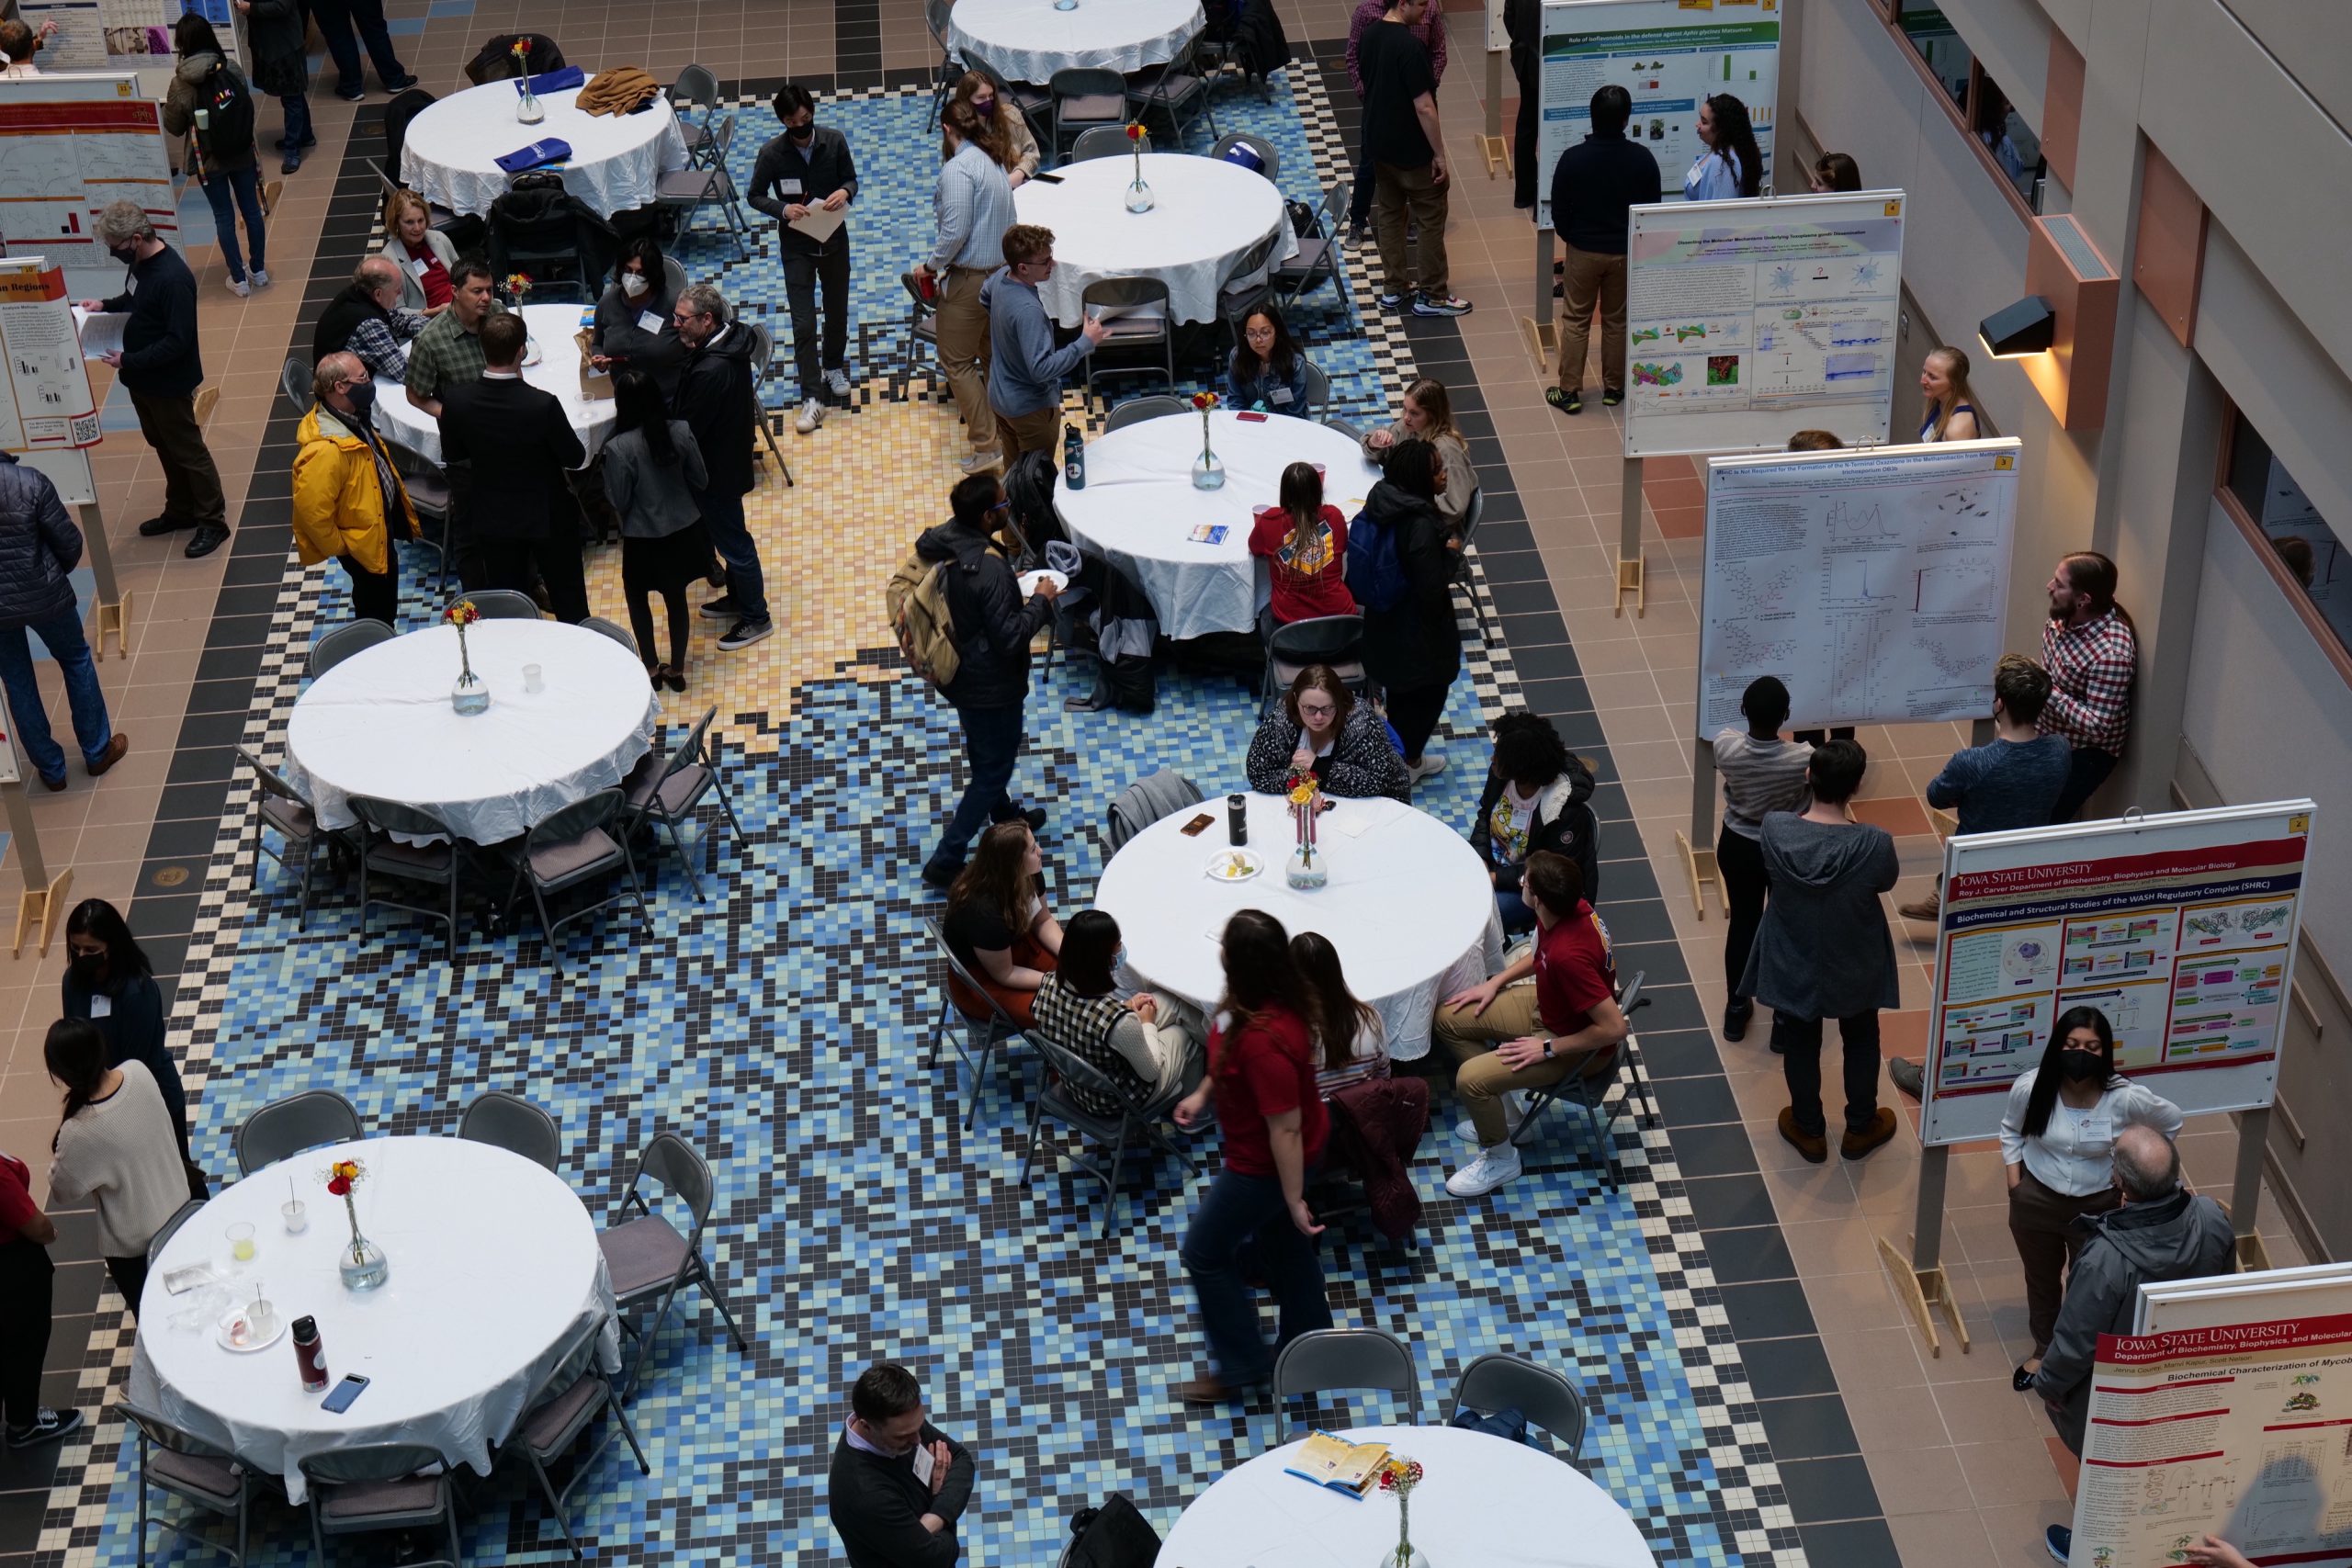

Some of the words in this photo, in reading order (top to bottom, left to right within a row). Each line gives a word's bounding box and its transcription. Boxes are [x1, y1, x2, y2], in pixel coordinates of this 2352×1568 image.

[11, 282, 50, 292] Regions
[1959, 890, 1973, 898] Roy
[1984, 885, 2008, 894] Carver
[2010, 881, 2052, 893] Department
[2063, 874, 2112, 886] Biochemistry,
[2114, 869, 2154, 880] Biophysics
[2171, 864, 2207, 874] Molecular
[2209, 861, 2236, 871] Biology
[1960, 875, 1989, 887] IOWA
[1992, 870, 2024, 884] STATE
[2028, 864, 2092, 880] UNIVERSITY
[1957, 910, 2007, 923] Biochemical
[2009, 908, 2025, 916] and
[2027, 902, 2068, 914] Structural
[2070, 899, 2100, 909] Studies
[2103, 897, 2112, 906] of
[2113, 897, 2127, 905] the
[2129, 893, 2154, 902] WASH
[2157, 888, 2202, 900] Regulatory
[2204, 884, 2239, 895] Complex
[2241, 880, 2270, 891] (SHRC)
[2115, 1350, 2165, 1361] Department
[2178, 1343, 2237, 1354] Biochemistry,
[2239, 1338, 2289, 1348] Biophysics,
[2310, 1330, 2352, 1341] Molecular
[2116, 1338, 2157, 1351] IOWA
[2160, 1332, 2205, 1348] STATE
[2210, 1323, 2300, 1342] UNIVERSITY
[2168, 1368, 2226, 1381] Biochemical
[2229, 1362, 2307, 1375] Characterization
[2209, 1356, 2227, 1364] Scott
